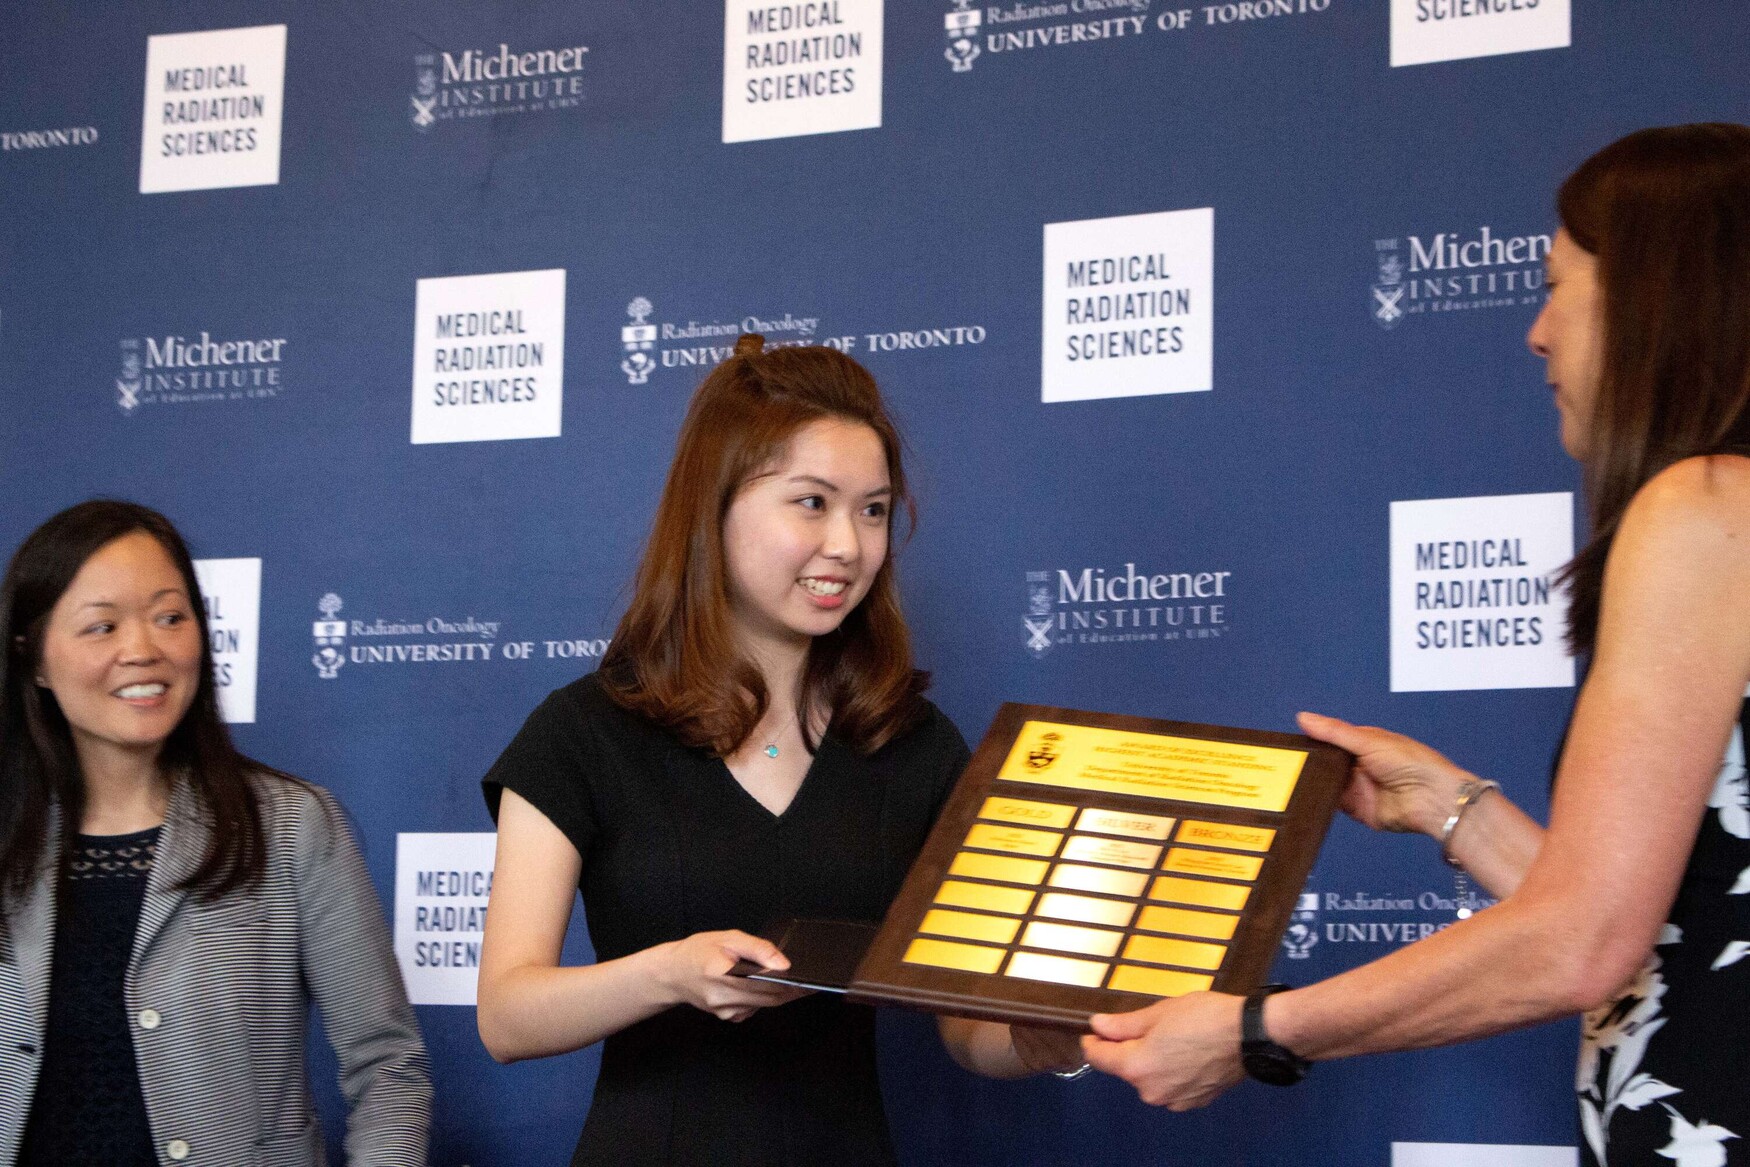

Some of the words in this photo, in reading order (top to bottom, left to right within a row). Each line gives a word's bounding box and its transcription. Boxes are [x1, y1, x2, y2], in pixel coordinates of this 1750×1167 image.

[748, 0, 843, 34] MEDICAL
[988, 15, 1147, 52] UNIVERSITY
[1158, 10, 1191, 30] OF
[1203, 0, 1330, 25] TORONTO
[442, 44, 589, 84] Michener
[747, 32, 861, 69] RADIATION
[165, 65, 247, 92] MEDICAL
[441, 77, 583, 106] INSTITUTE
[747, 68, 854, 103] SCIENCES
[164, 96, 263, 123] RADIATION
[2, 127, 98, 150] TORONTO
[162, 127, 256, 157] SCIENCES
[1408, 226, 1552, 272] Michen
[1068, 254, 1171, 288] MEDICAL
[1411, 269, 1543, 299] INSTITU
[1068, 289, 1189, 324] RADIATION
[437, 311, 525, 338] MEDICAL
[866, 326, 986, 352] TORONTO
[146, 332, 287, 368] Michener
[436, 343, 542, 371] RADIATION
[1068, 326, 1182, 361] SCIENCES
[145, 368, 280, 391] INSTITUTE
[435, 377, 535, 406] SCIENCES
[1417, 539, 1527, 570] MEDICAL
[1058, 563, 1230, 603] Michener
[1417, 577, 1549, 610] RADIATION
[1059, 605, 1225, 629] INSTITUTE
[1418, 617, 1542, 649] SCIENCES
[351, 643, 493, 663] UNIVERSITY
[503, 642, 534, 659] OF
[544, 640, 611, 658] TORO
[416, 906, 488, 932] RADIAT
[415, 941, 478, 967] SCIEN
